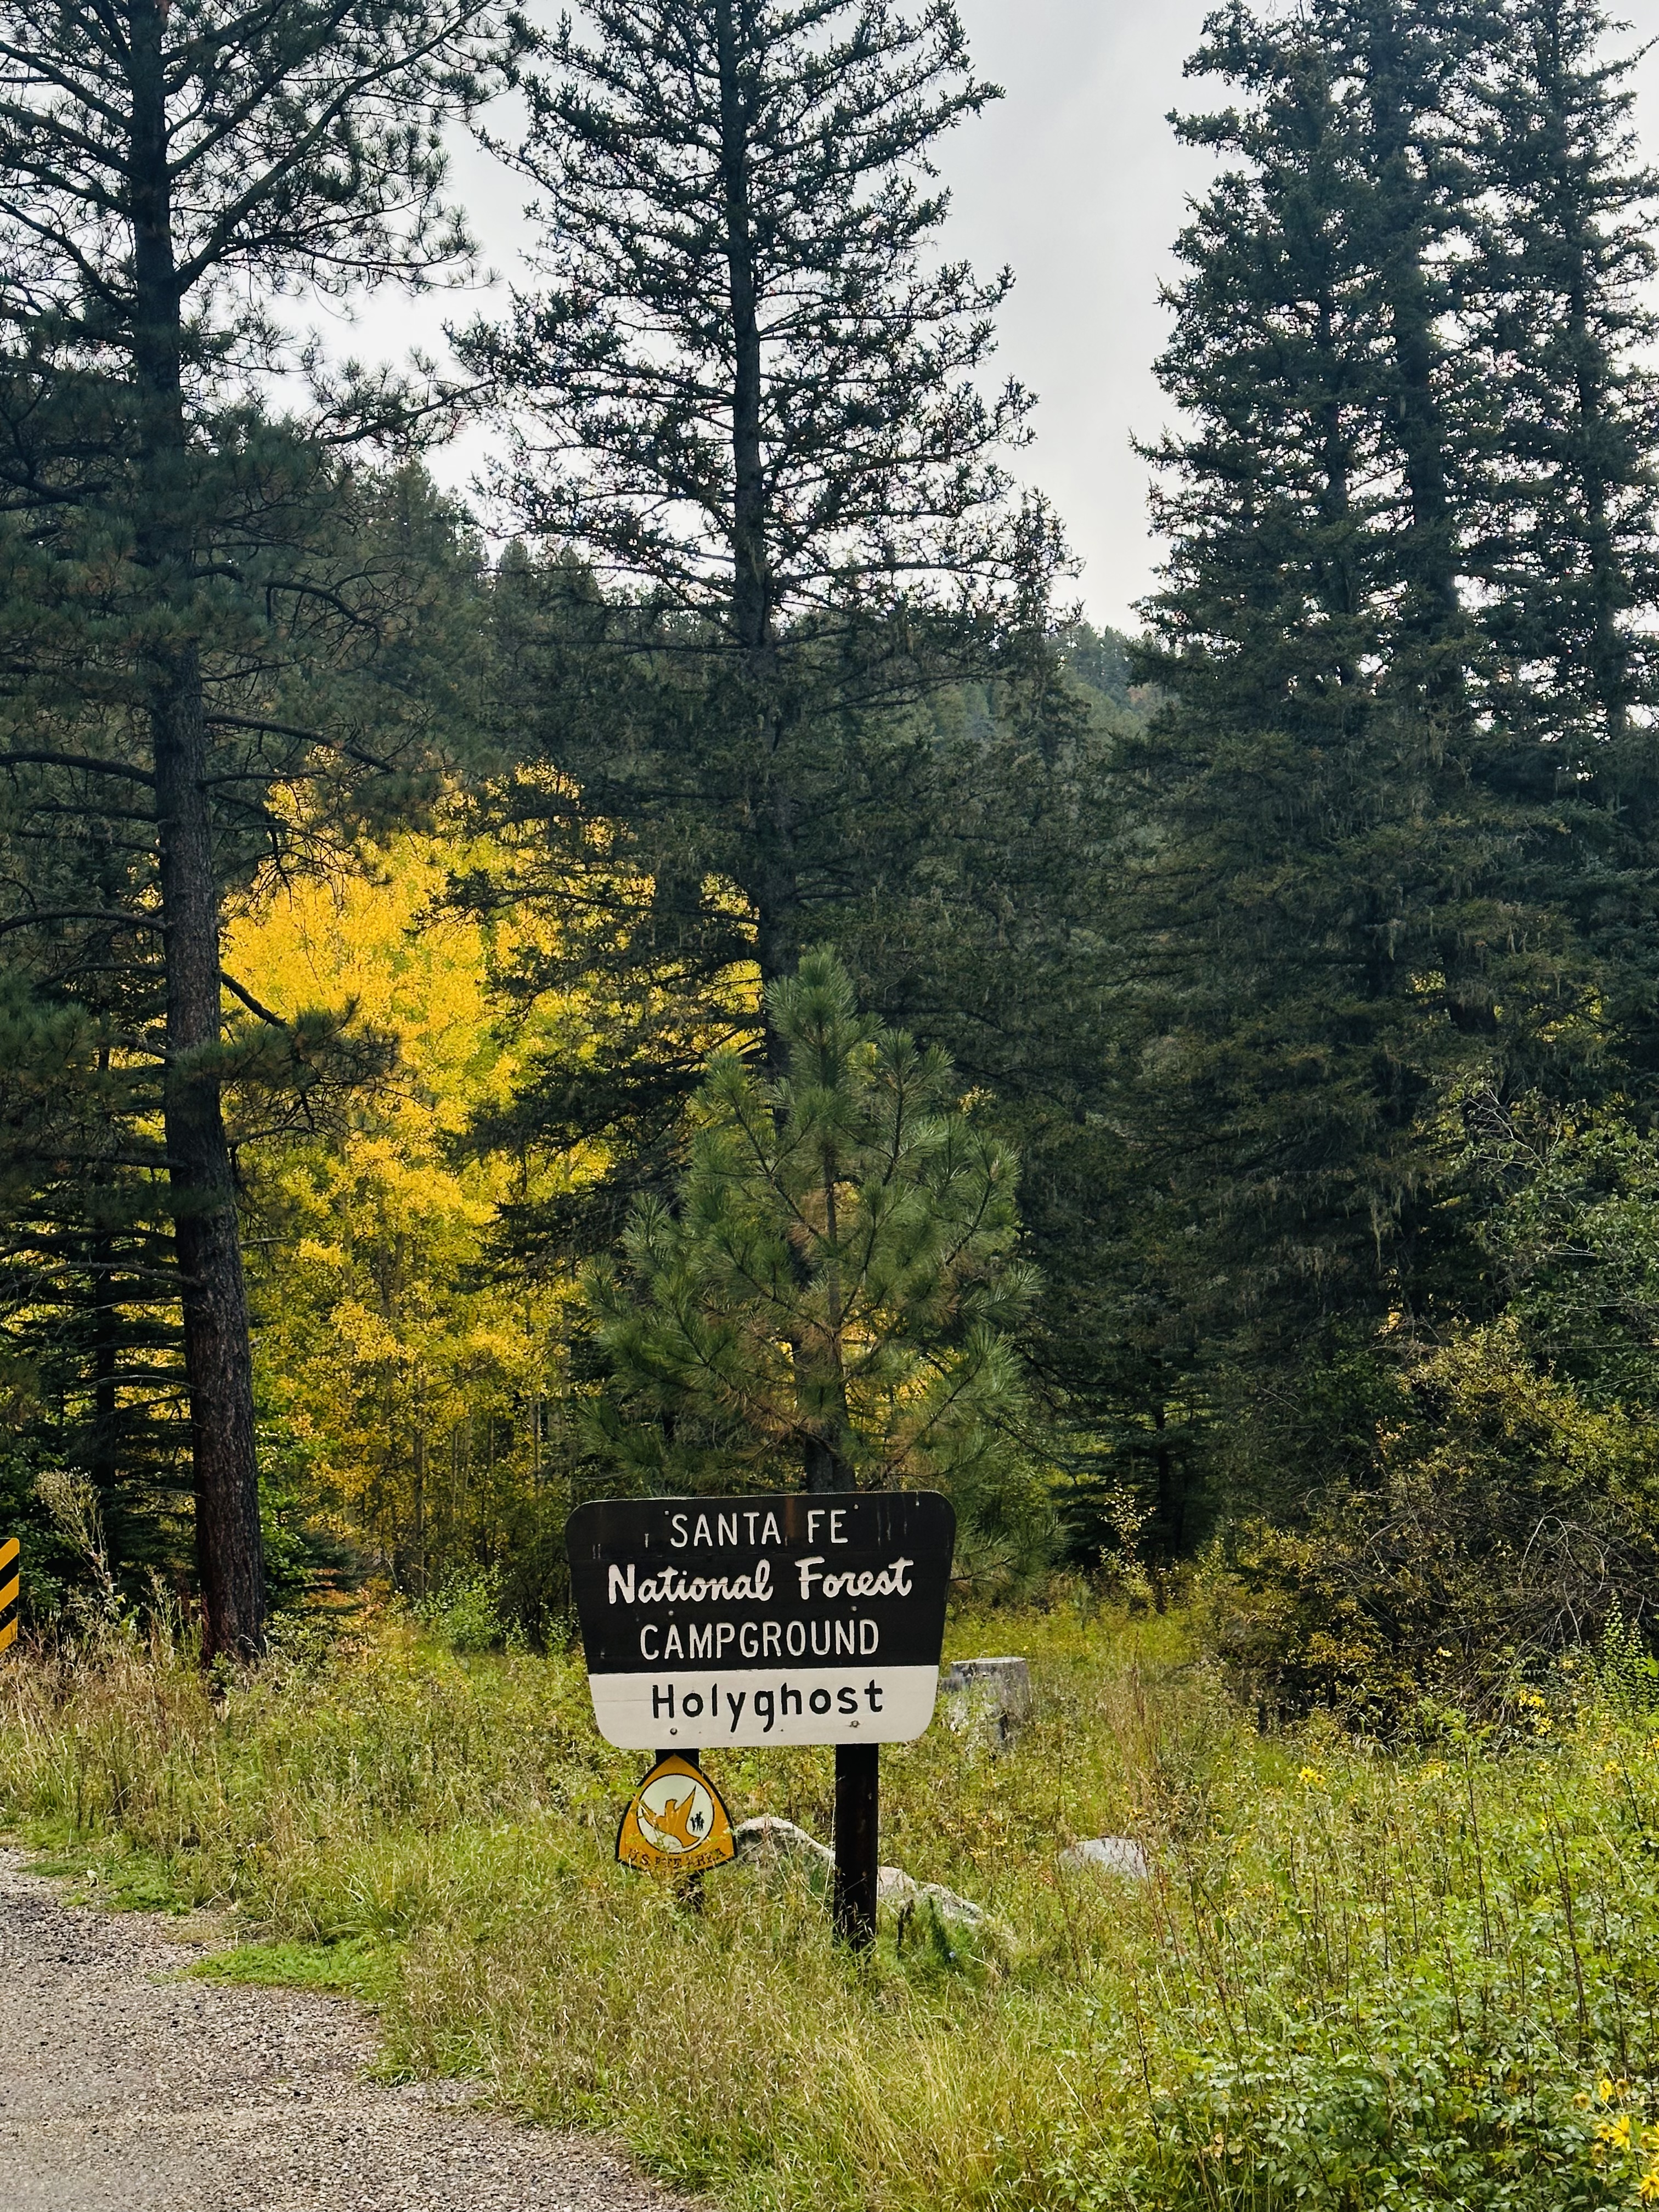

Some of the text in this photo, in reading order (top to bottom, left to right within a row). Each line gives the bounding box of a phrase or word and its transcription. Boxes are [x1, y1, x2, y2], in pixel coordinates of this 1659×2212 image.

[670, 1509, 848, 1548] SANTA FE
[608, 1556, 914, 1605] National Forest
[640, 1619, 879, 1660] CAMPGROUND
[652, 1679, 883, 1734] Holyghost
